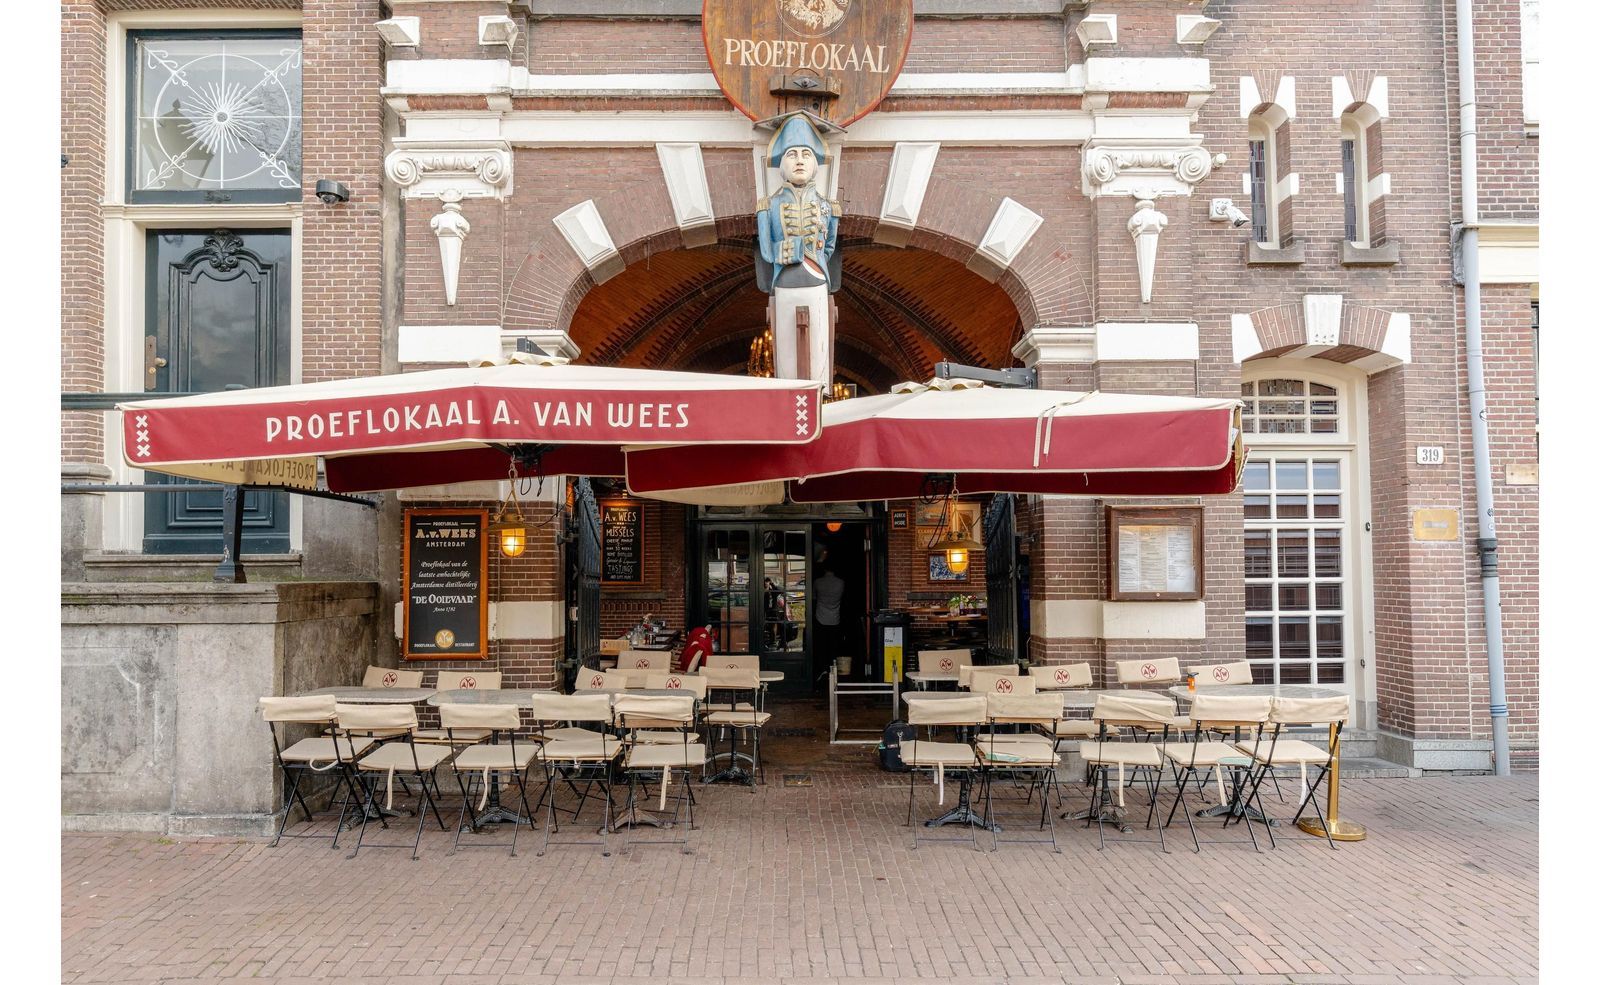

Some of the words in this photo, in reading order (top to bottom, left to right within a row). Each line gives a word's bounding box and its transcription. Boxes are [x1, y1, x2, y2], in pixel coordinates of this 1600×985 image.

[724, 38, 889, 73] PROEFLOKAAL
[266, 400, 481, 442] PROEFLOKAAL
[493, 400, 520, 425] A.
[533, 401, 592, 426] VAN
[607, 403, 689, 428] WEES
[1422, 449, 1440, 462] 319
[606, 528, 635, 538] MUSSELS
[421, 560, 450, 569] Proeflokaal
[410, 581, 444, 590] Amsterdamse
